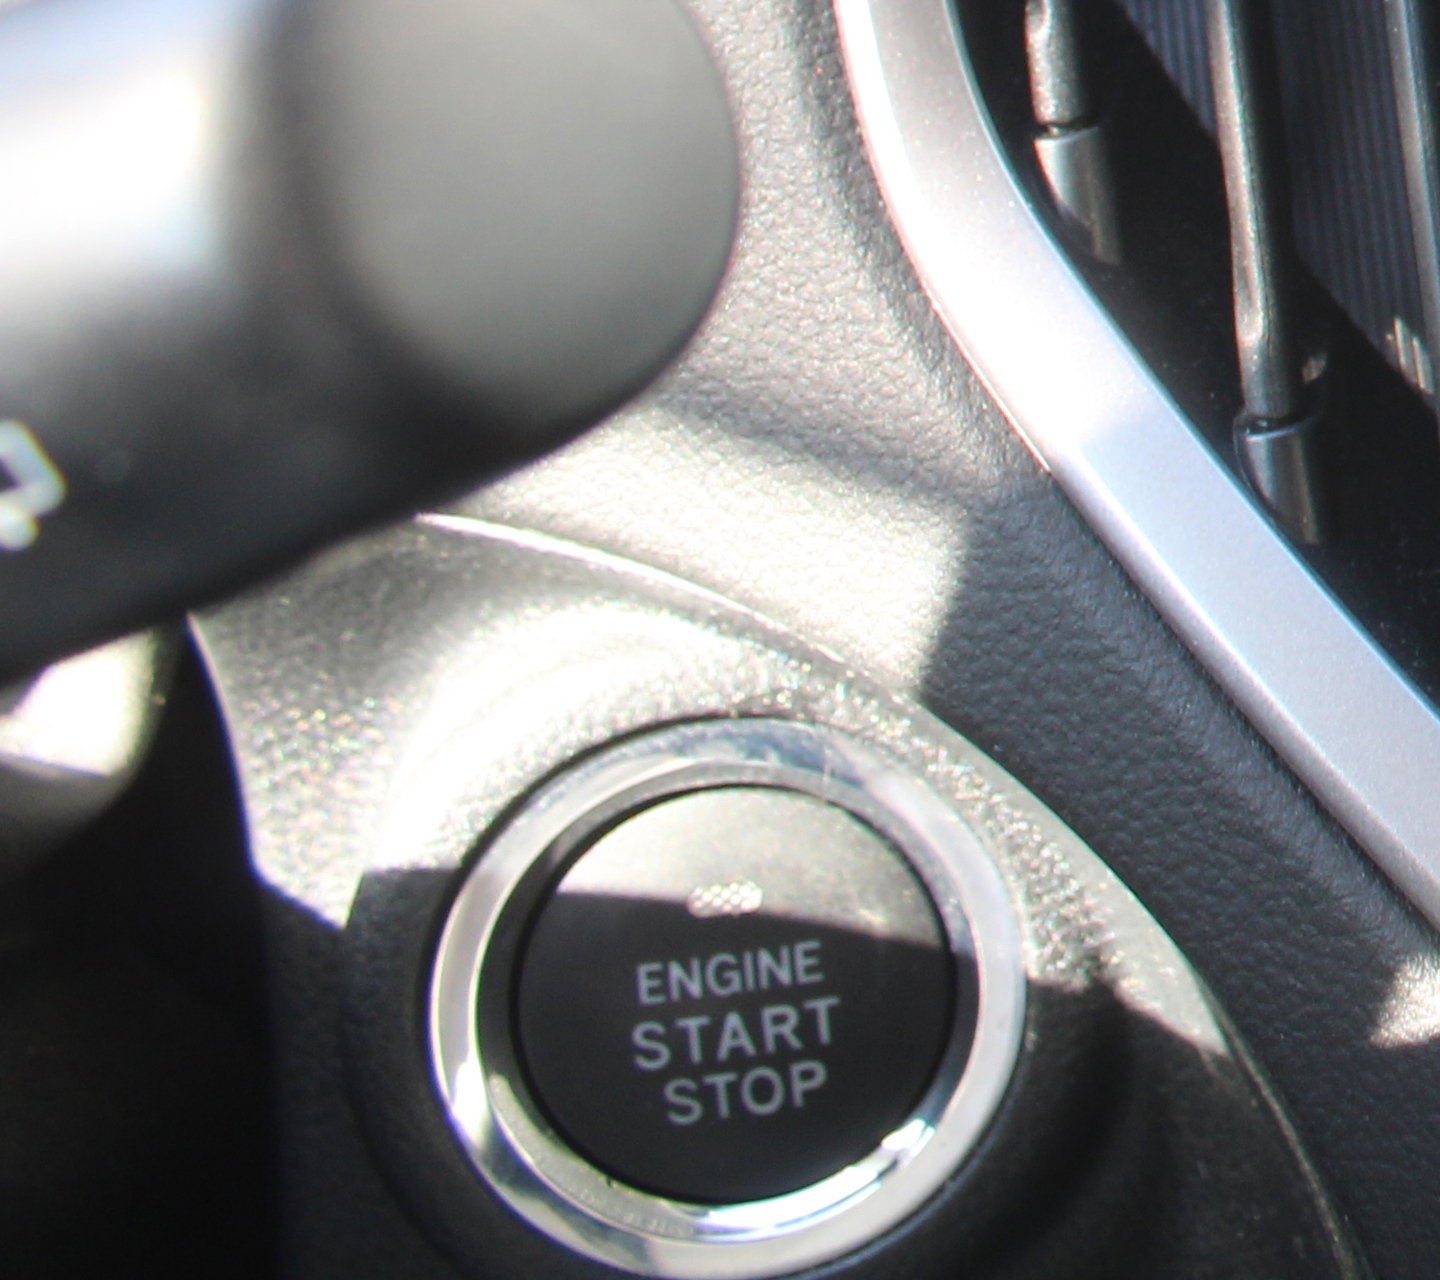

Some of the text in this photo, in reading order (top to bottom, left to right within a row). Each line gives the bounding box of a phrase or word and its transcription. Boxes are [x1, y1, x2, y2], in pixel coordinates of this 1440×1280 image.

[636, 940, 826, 1006] ENGINE
[630, 996, 841, 1072] START
[664, 1060, 829, 1128] STOP
